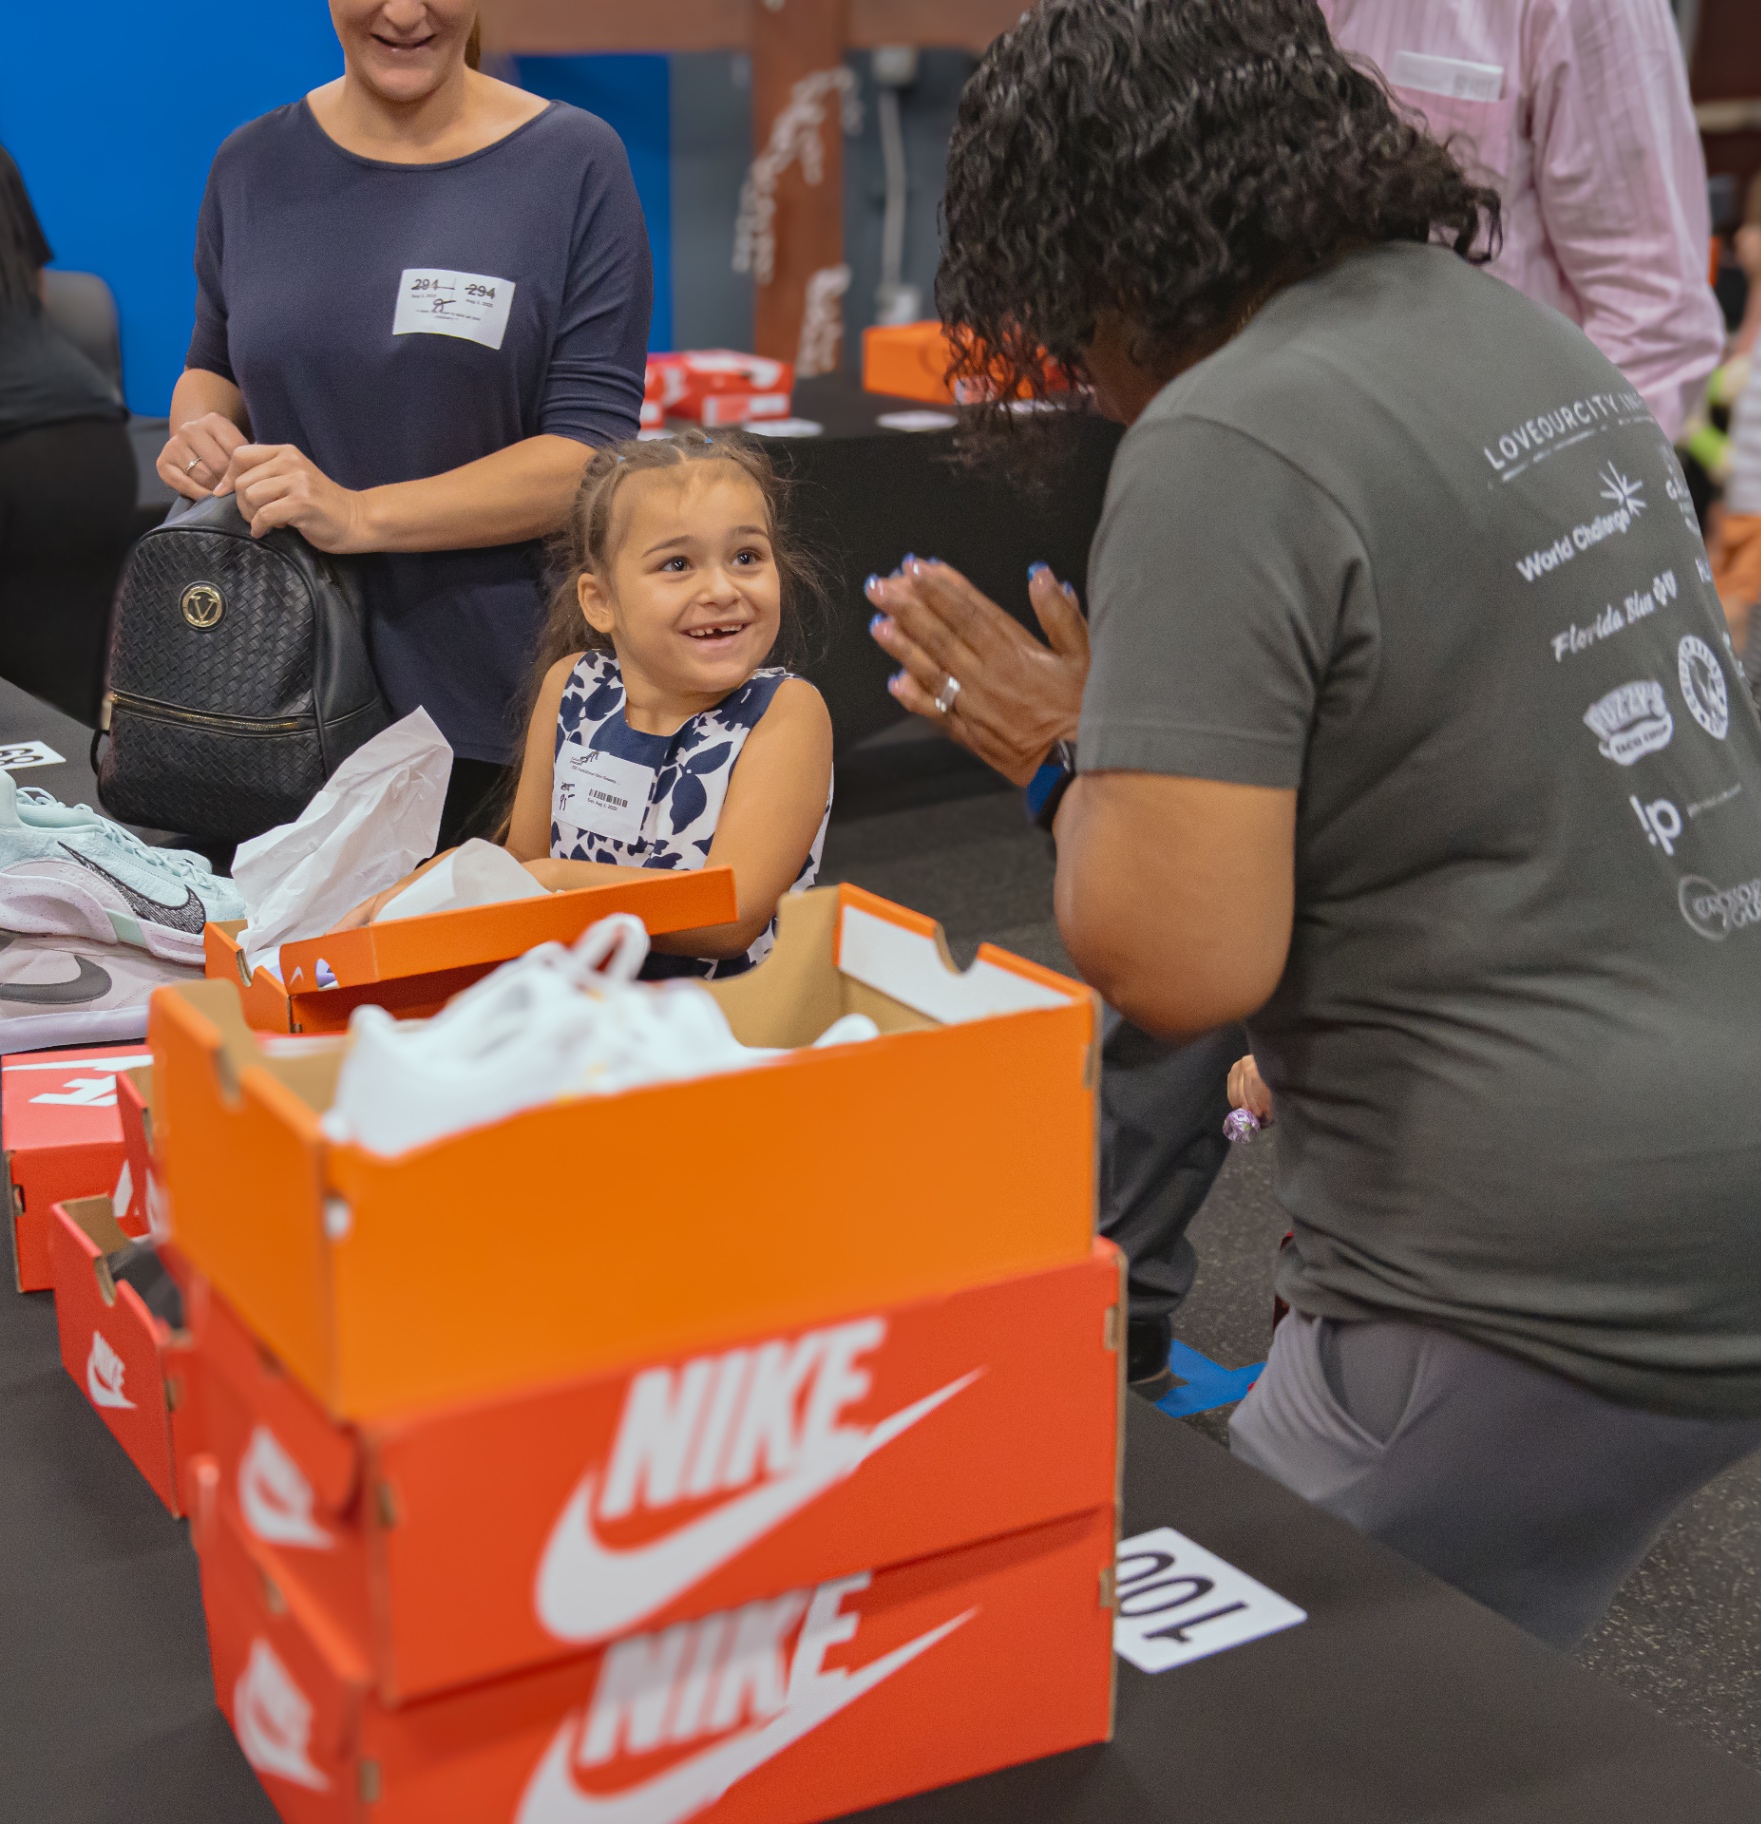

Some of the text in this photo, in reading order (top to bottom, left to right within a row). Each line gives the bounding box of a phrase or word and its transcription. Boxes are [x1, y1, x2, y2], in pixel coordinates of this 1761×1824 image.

[1484, 394, 1619, 471] LOVEOURCITY
[1516, 534, 1576, 582] World
[1551, 603, 1626, 663] Florida
[600, 1316, 887, 1521] NIKE
[580, 1568, 875, 1767] NIKE
